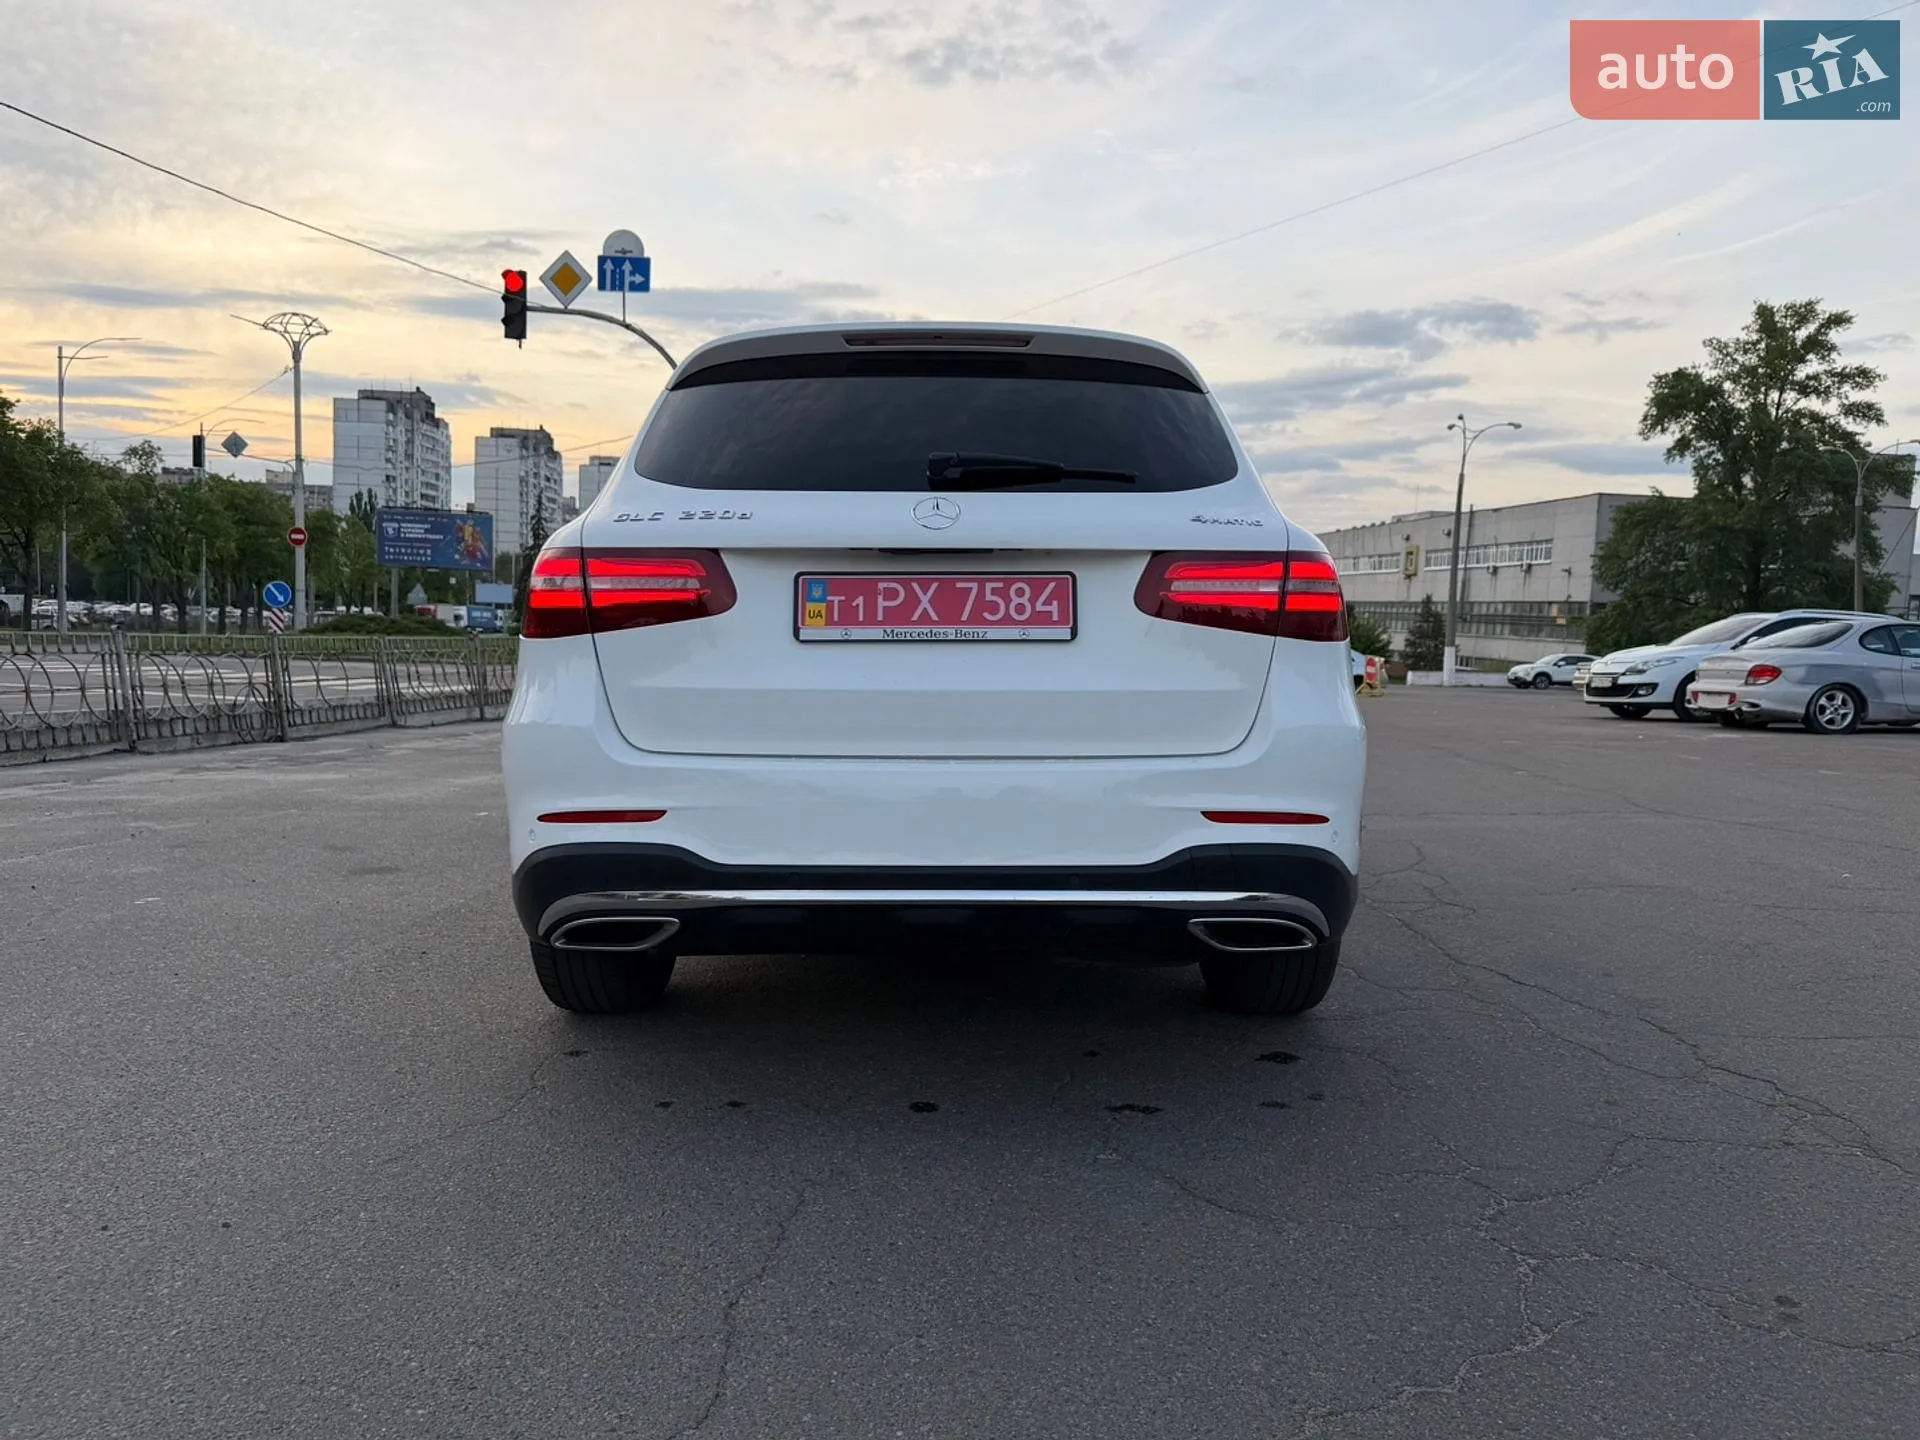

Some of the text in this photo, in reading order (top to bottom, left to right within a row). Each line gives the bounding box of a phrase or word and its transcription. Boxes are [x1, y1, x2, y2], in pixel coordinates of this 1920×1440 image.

[613, 510, 753, 523] GLC 220d
[1189, 515, 1264, 527] 4MATIC
[956, 582, 1058, 621] 7584
[808, 609, 823, 619] UA
[882, 629, 989, 639] Mercedes-Benz
